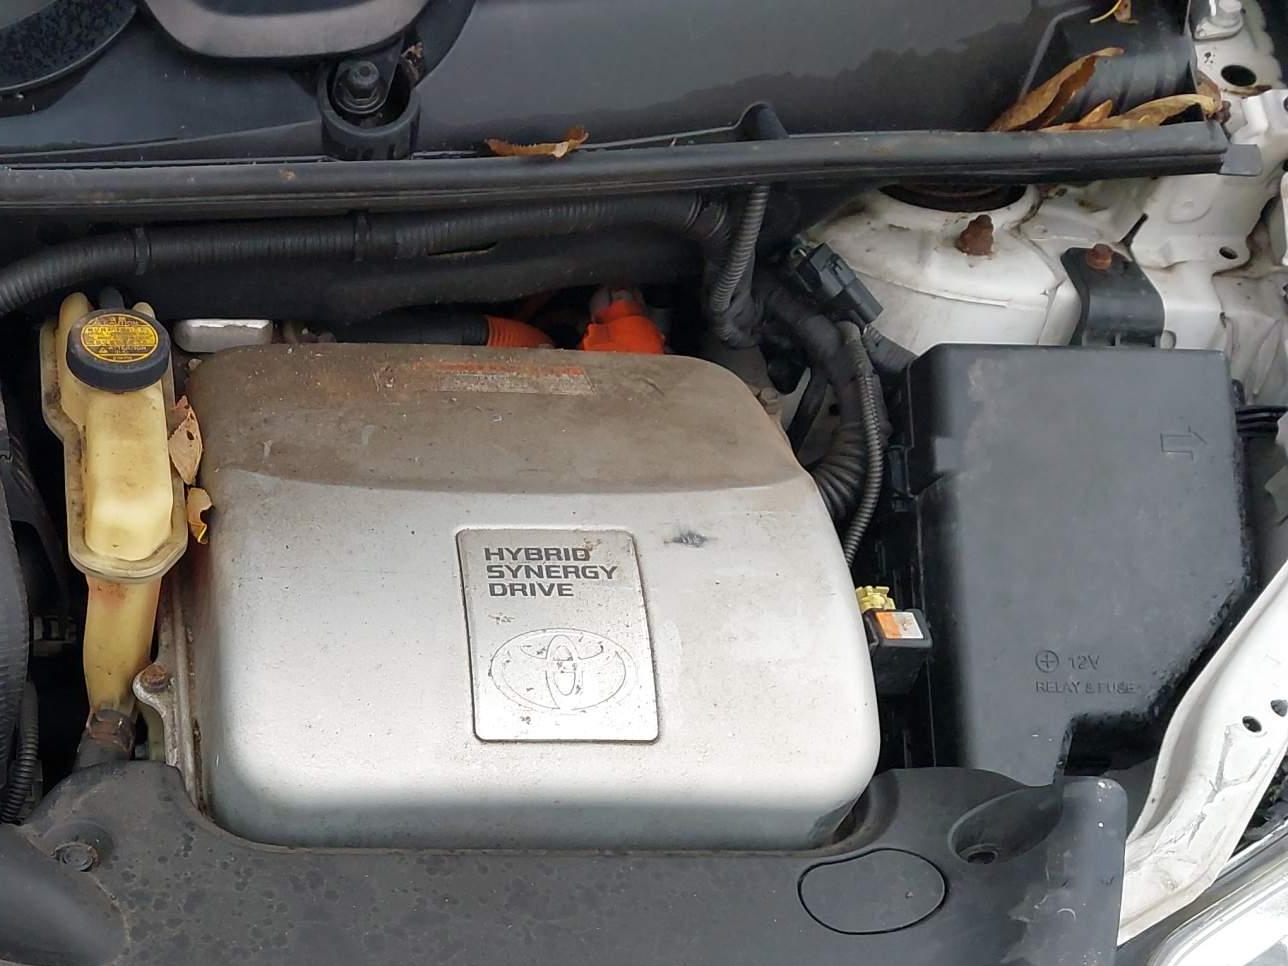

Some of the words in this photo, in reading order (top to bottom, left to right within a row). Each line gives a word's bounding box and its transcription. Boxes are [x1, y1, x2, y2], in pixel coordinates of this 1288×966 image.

[484, 547, 591, 562] HYBRID
[486, 564, 618, 580] SYNERGY
[488, 582, 574, 597] DRIVE
[1067, 655, 1100, 671] 12V
[1035, 680, 1081, 694] RELAY
[1097, 680, 1136, 694] FUSE
